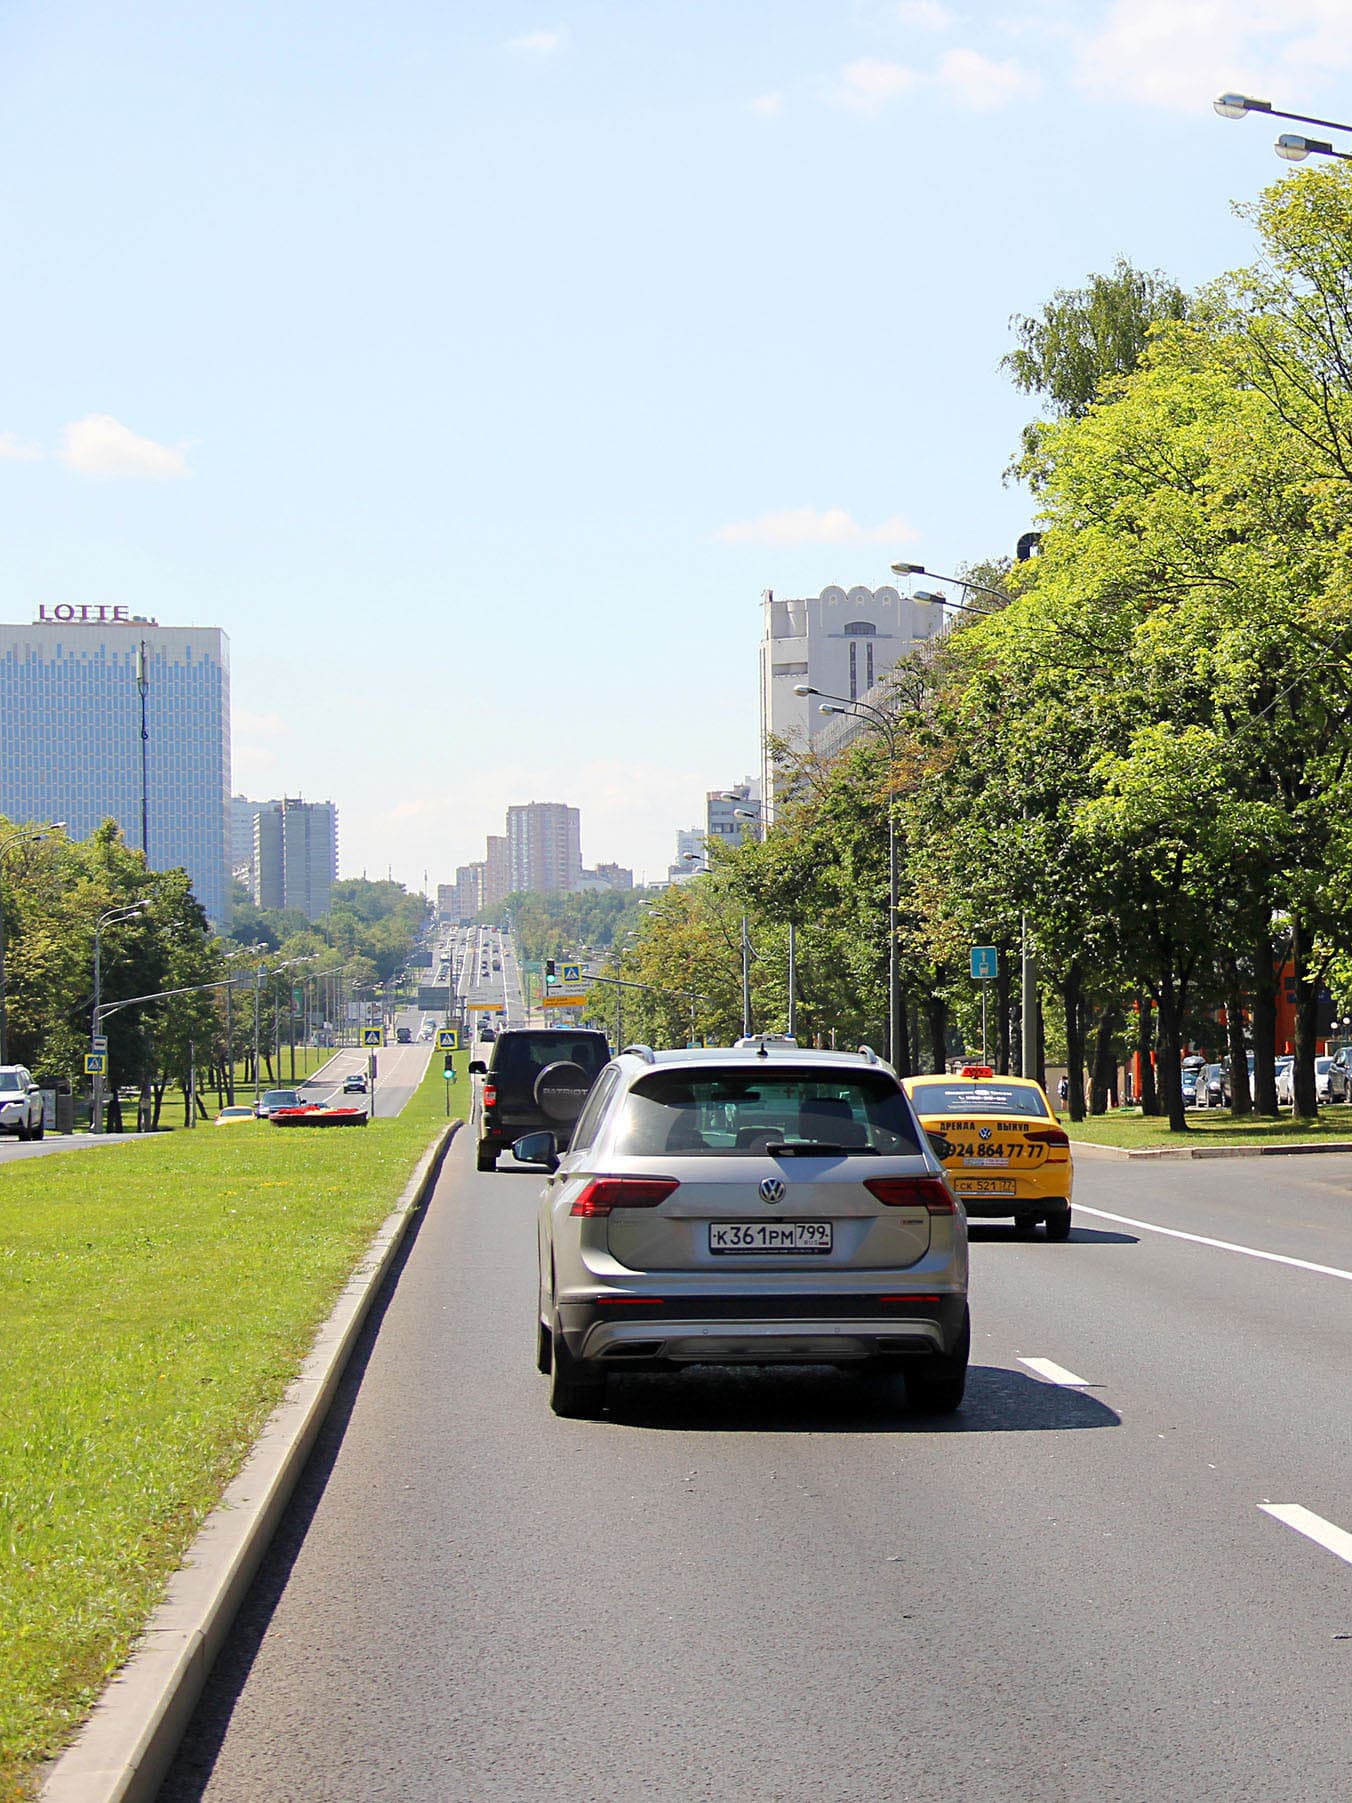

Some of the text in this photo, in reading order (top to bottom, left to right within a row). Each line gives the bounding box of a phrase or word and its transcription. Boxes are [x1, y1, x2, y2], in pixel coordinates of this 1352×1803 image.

[39, 604, 128, 621] LOTTE
[977, 1143, 1003, 1157] 864
[1007, 1144, 1024, 1157] 77
[1027, 1145, 1043, 1158] 77
[977, 1181, 996, 1190] 521
[797, 1225, 826, 1240] 799
